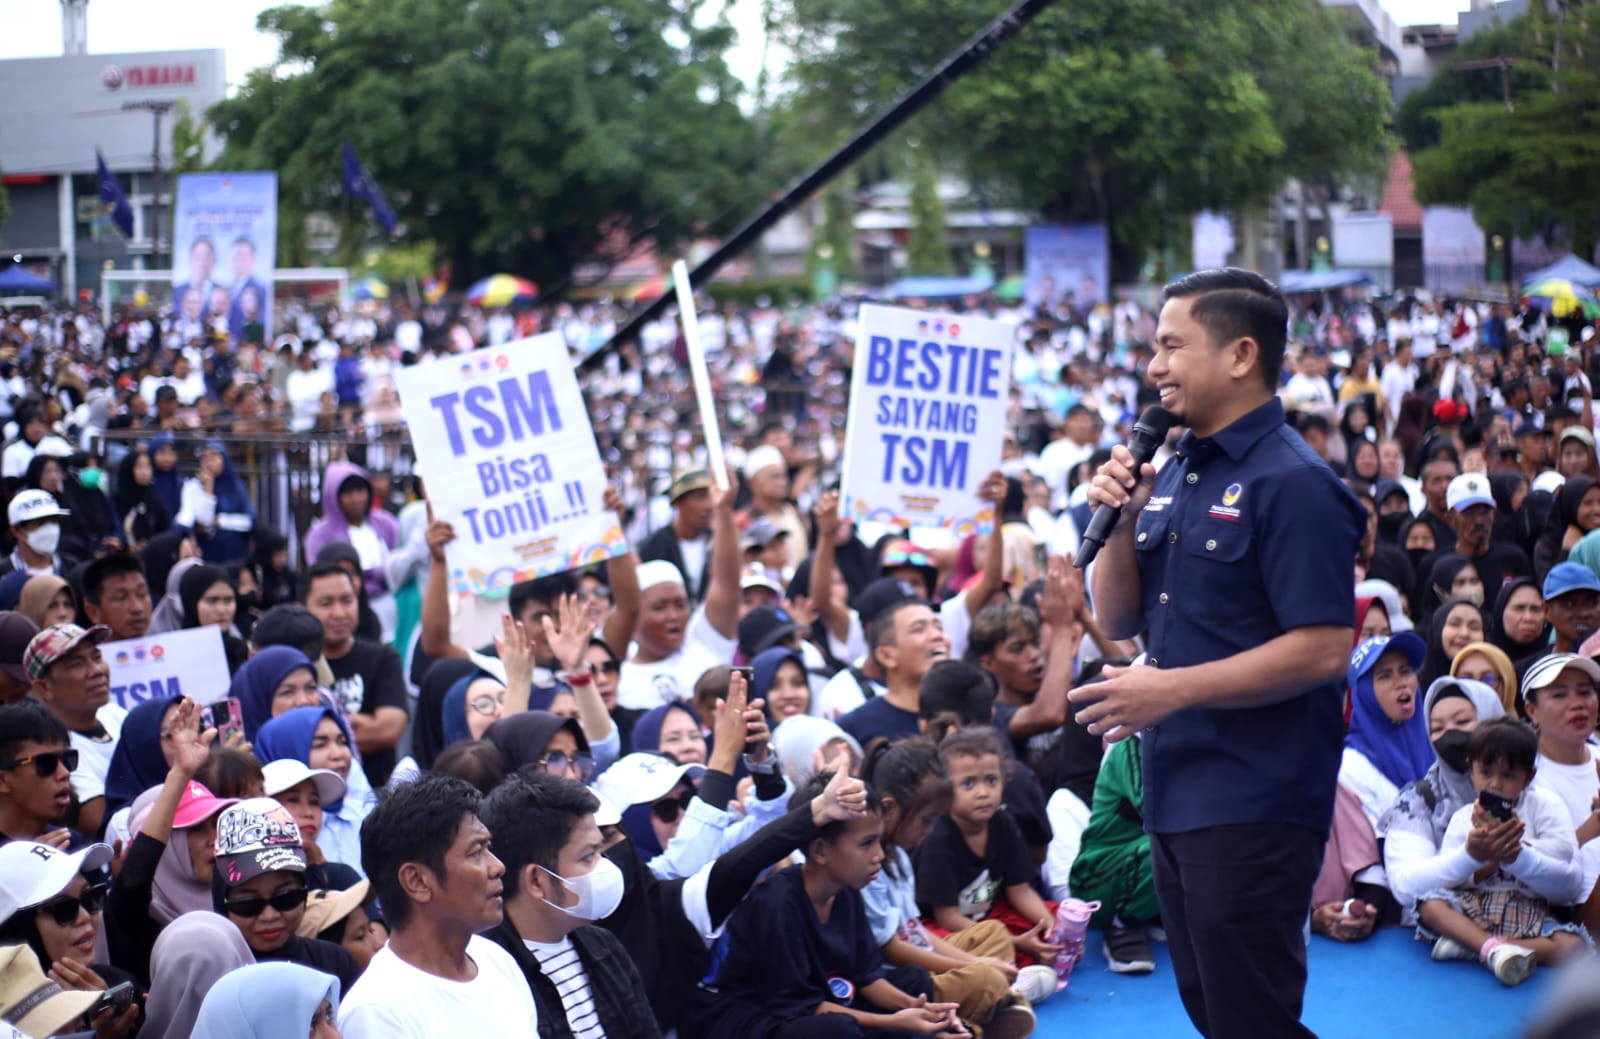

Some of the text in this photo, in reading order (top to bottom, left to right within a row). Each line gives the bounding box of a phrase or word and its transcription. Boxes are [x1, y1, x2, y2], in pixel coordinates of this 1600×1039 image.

[866, 335, 1002, 399] BESTIE
[430, 369, 563, 458] TSM
[876, 394, 978, 435] SAYANG
[476, 452, 554, 499] Bisa
[881, 433, 970, 490] TSM
